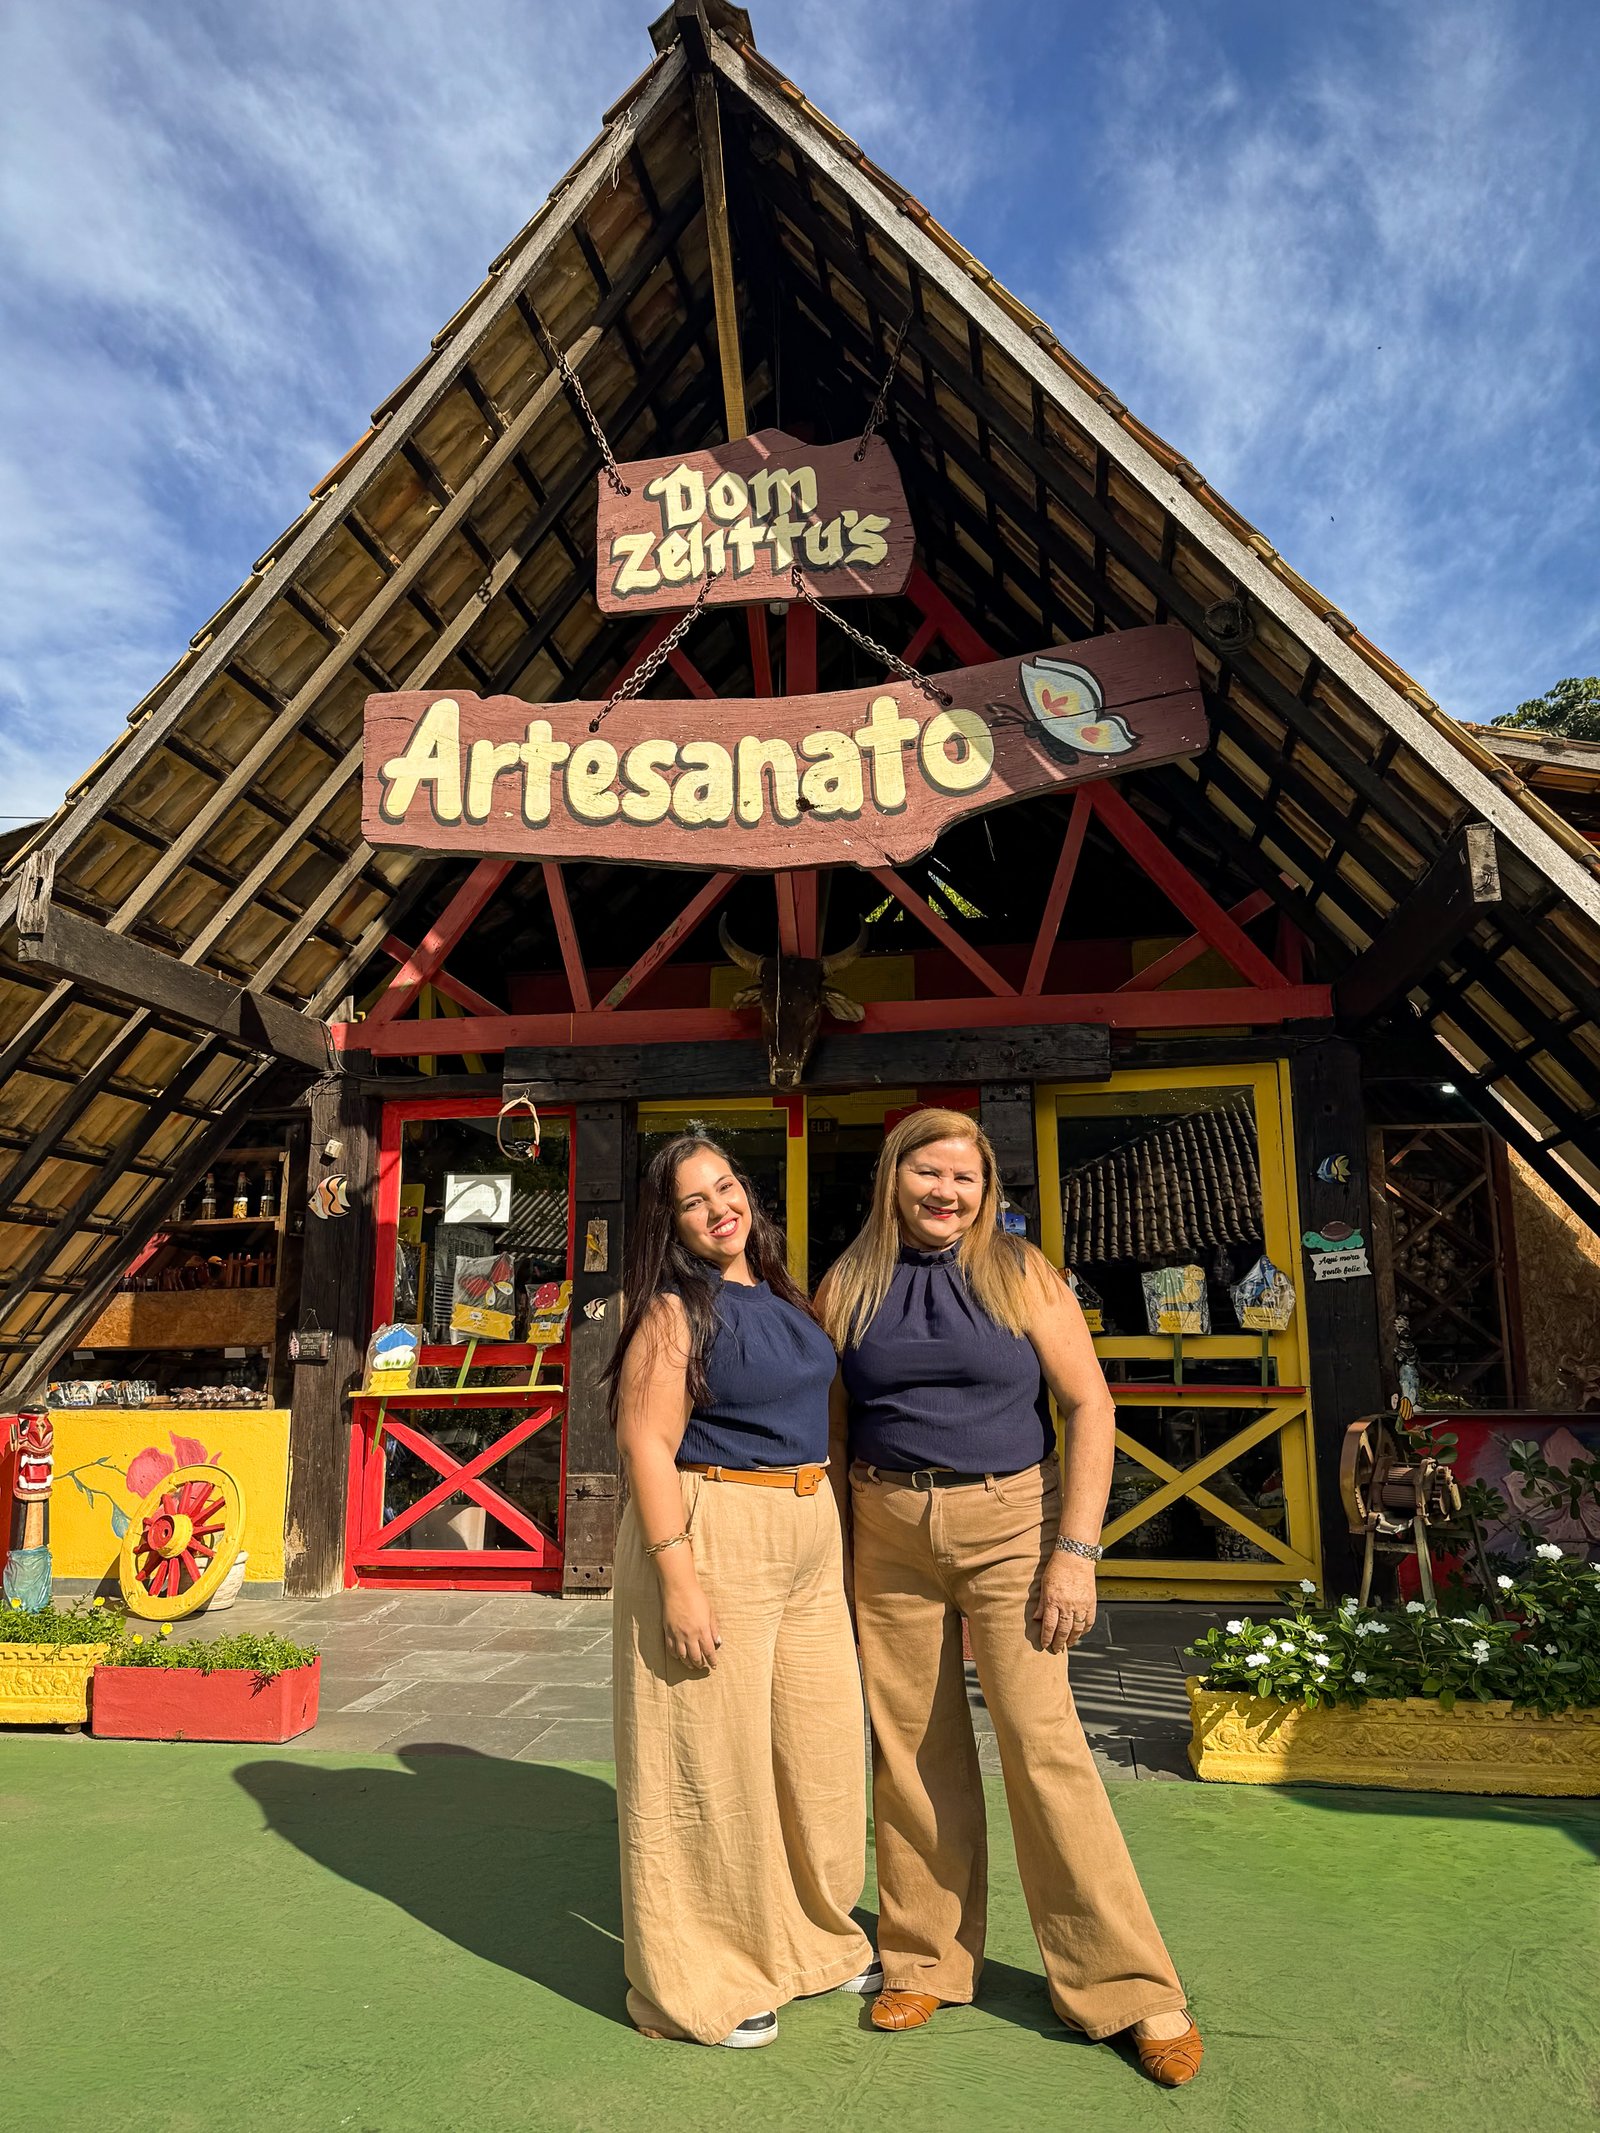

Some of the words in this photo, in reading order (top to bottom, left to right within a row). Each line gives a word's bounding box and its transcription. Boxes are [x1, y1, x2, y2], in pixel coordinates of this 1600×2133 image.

[646, 463, 818, 529] Dom
[381, 695, 994, 823] Artesanato
[1319, 1256, 1338, 1265] Aqui
[1343, 1265, 1361, 1275] feliz
